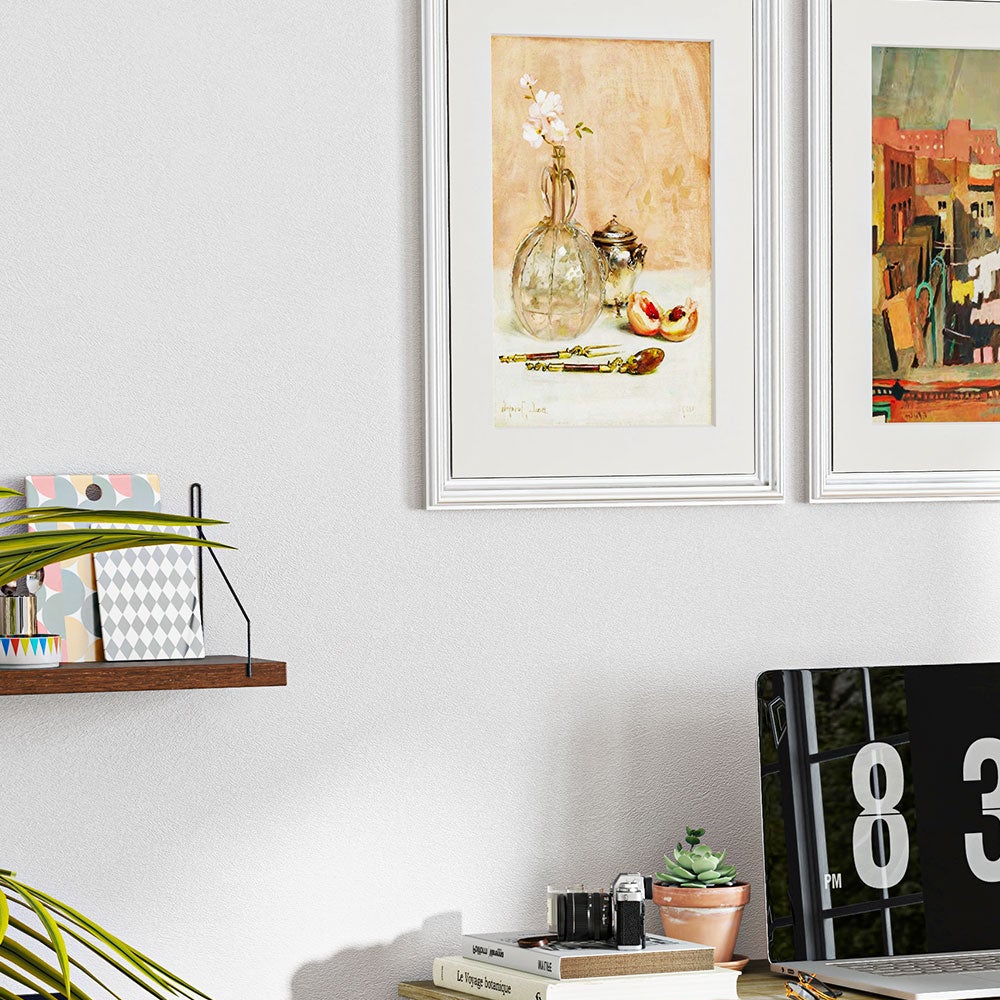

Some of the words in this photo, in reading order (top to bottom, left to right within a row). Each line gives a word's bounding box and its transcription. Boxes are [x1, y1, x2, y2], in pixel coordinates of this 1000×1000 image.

[851, 741, 911, 889] 8
[824, 873, 842, 889] PM
[465, 972, 483, 989] Voyage
[485, 977, 511, 995] botanique
